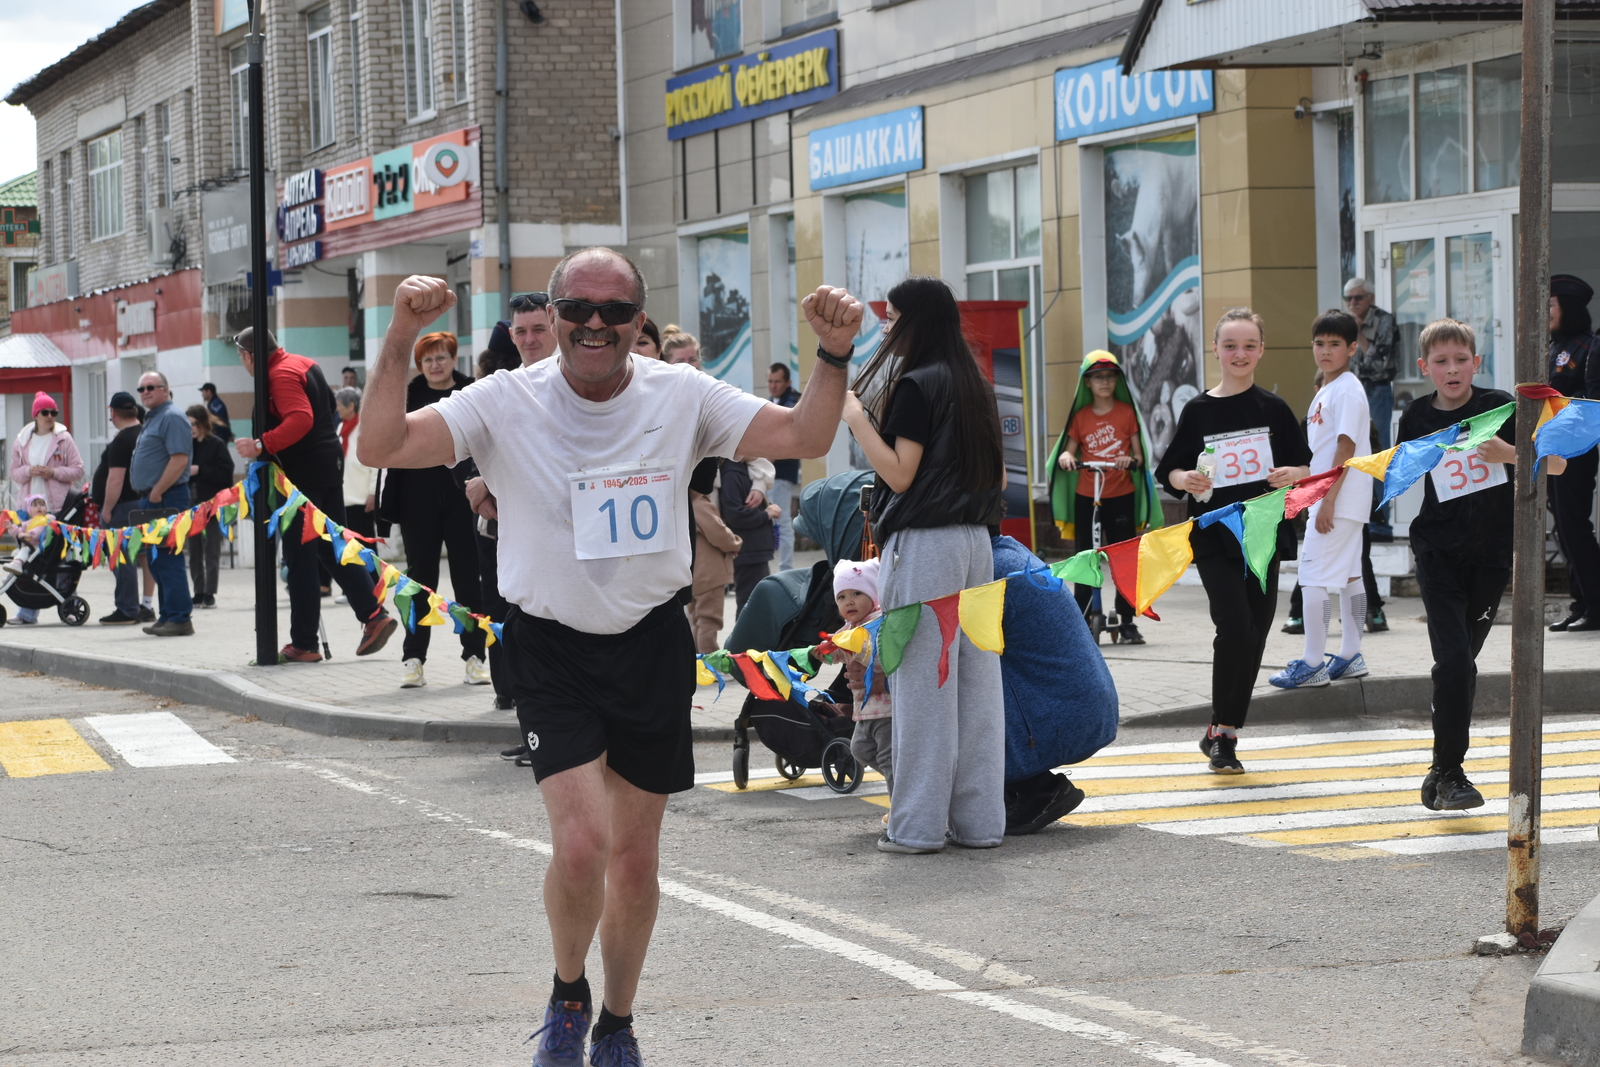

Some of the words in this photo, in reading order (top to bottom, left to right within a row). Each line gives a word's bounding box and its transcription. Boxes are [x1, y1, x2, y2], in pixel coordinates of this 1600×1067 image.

[665, 64, 733, 127] РУССКИЙ
[735, 47, 830, 107] ФЕЙЕРВЕРК
[1057, 67, 1210, 127] КОЛОСОК
[810, 111, 923, 180] БАШАККАЙ
[284, 168, 317, 208] АПТЕКА
[0, 222, 26, 232] ПТЕКА
[285, 204, 318, 242] АПРЕЛЬ
[1003, 419, 1018, 433] RB
[1085, 434, 1096, 443] NO
[1094, 425, 1115, 439] LIMITS
[1088, 440, 1098, 449] NO
[603, 479, 622, 489] 1945
[629, 475, 648, 486] 2025
[1221, 448, 1262, 479] 33
[1443, 452, 1490, 490] 35
[598, 494, 659, 543] 10
